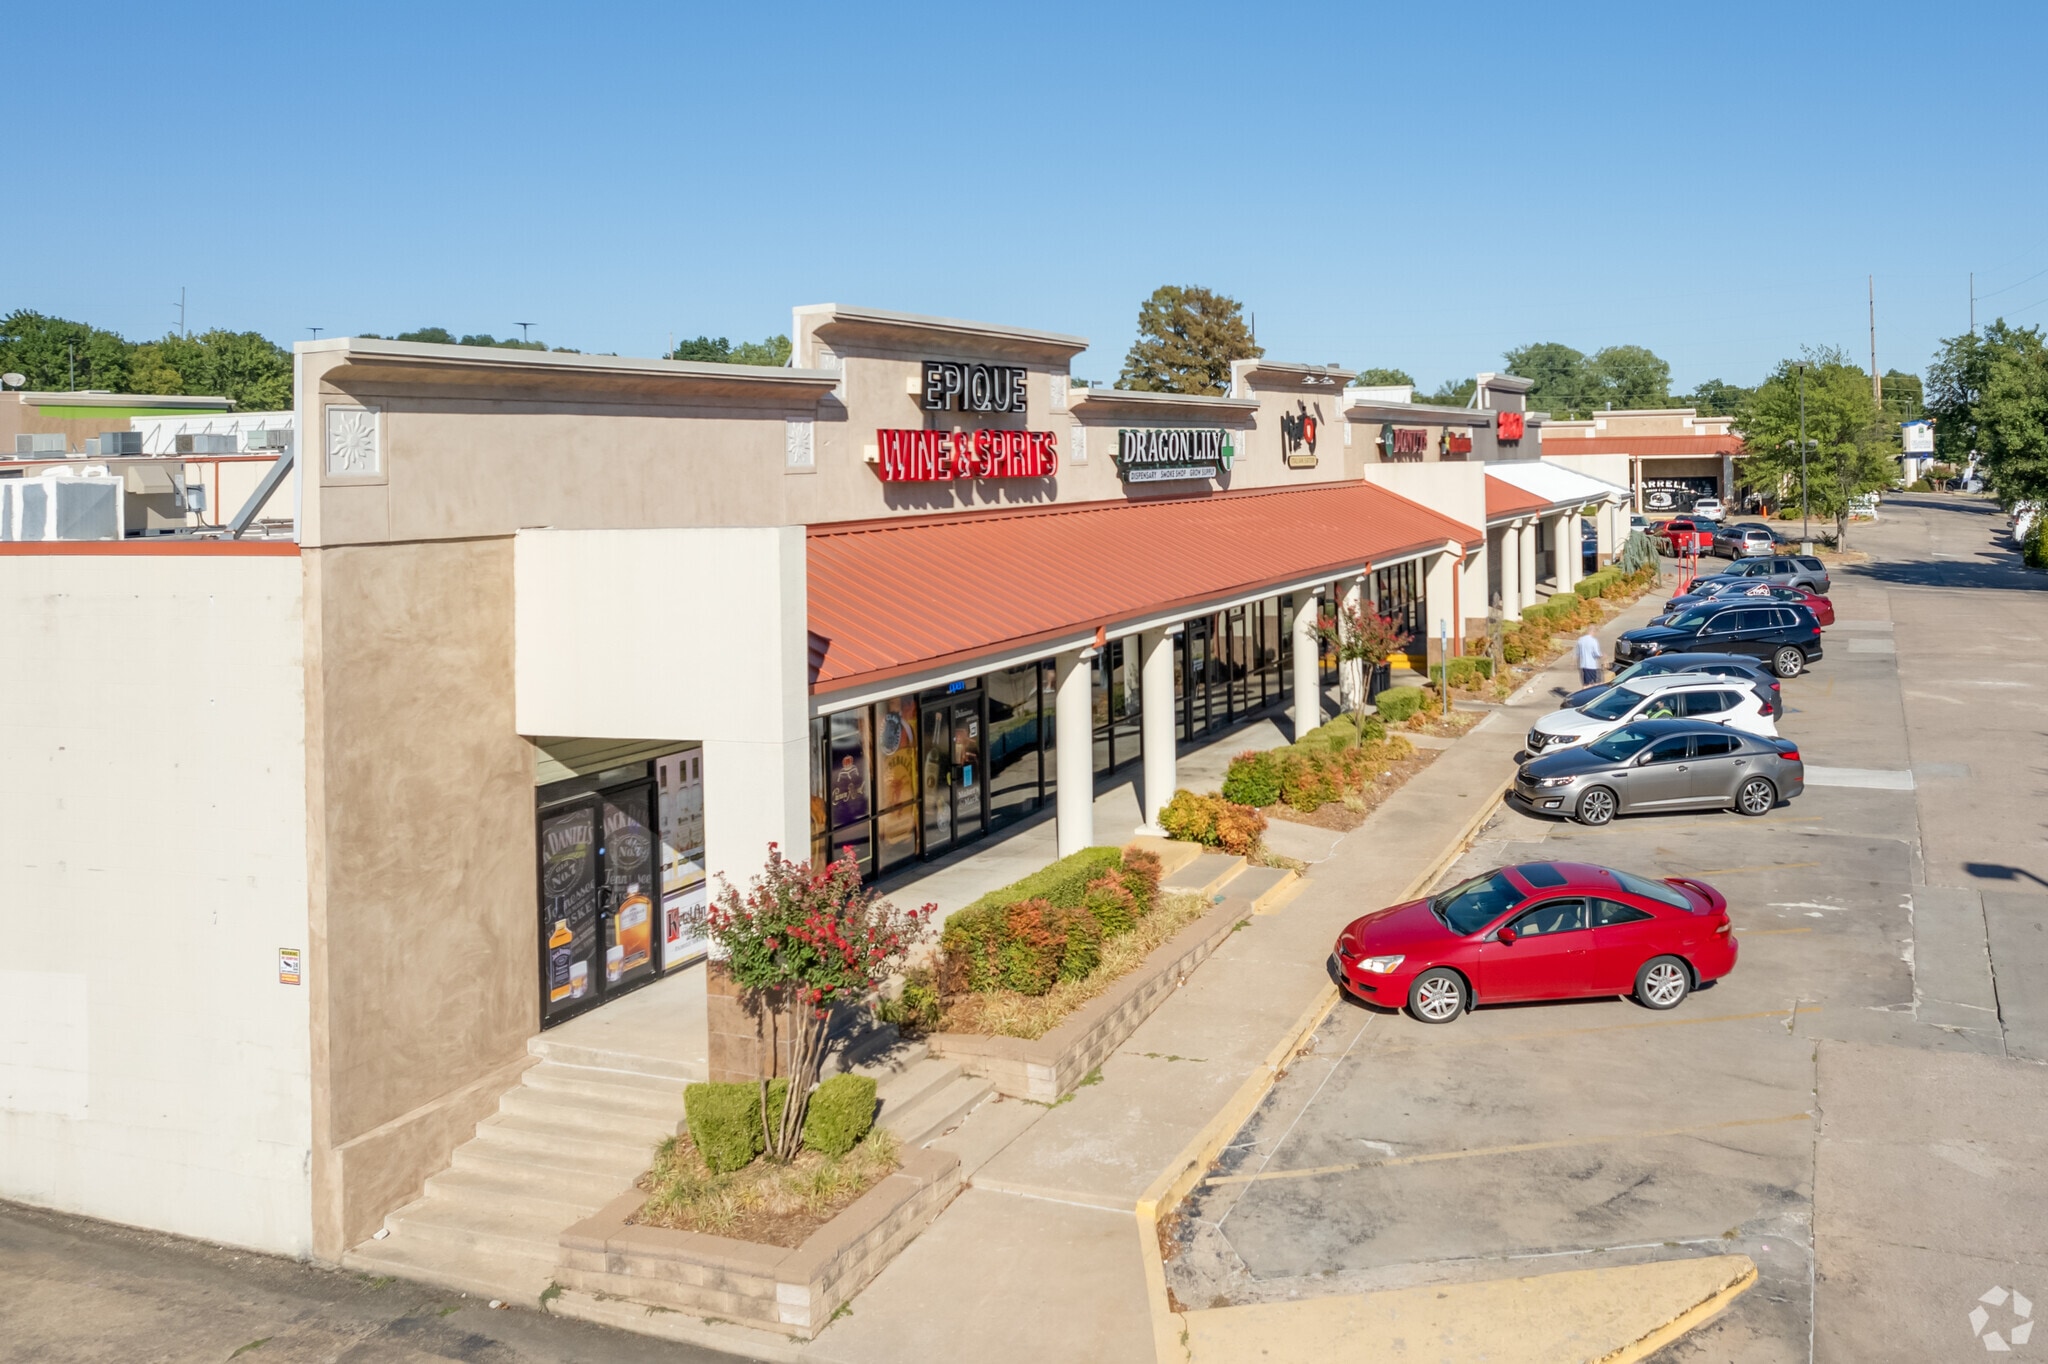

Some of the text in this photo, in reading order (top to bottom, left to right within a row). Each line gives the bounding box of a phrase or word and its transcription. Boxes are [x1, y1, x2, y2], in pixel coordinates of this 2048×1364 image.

[923, 362, 1027, 413] EPIQUE
[877, 429, 1058, 482] WINE & SPIRITS
[1122, 431, 1221, 463] DRAGON LILY
[1131, 471, 1157, 480] DISPENSARY
[1175, 469, 1187, 477] SHOP
